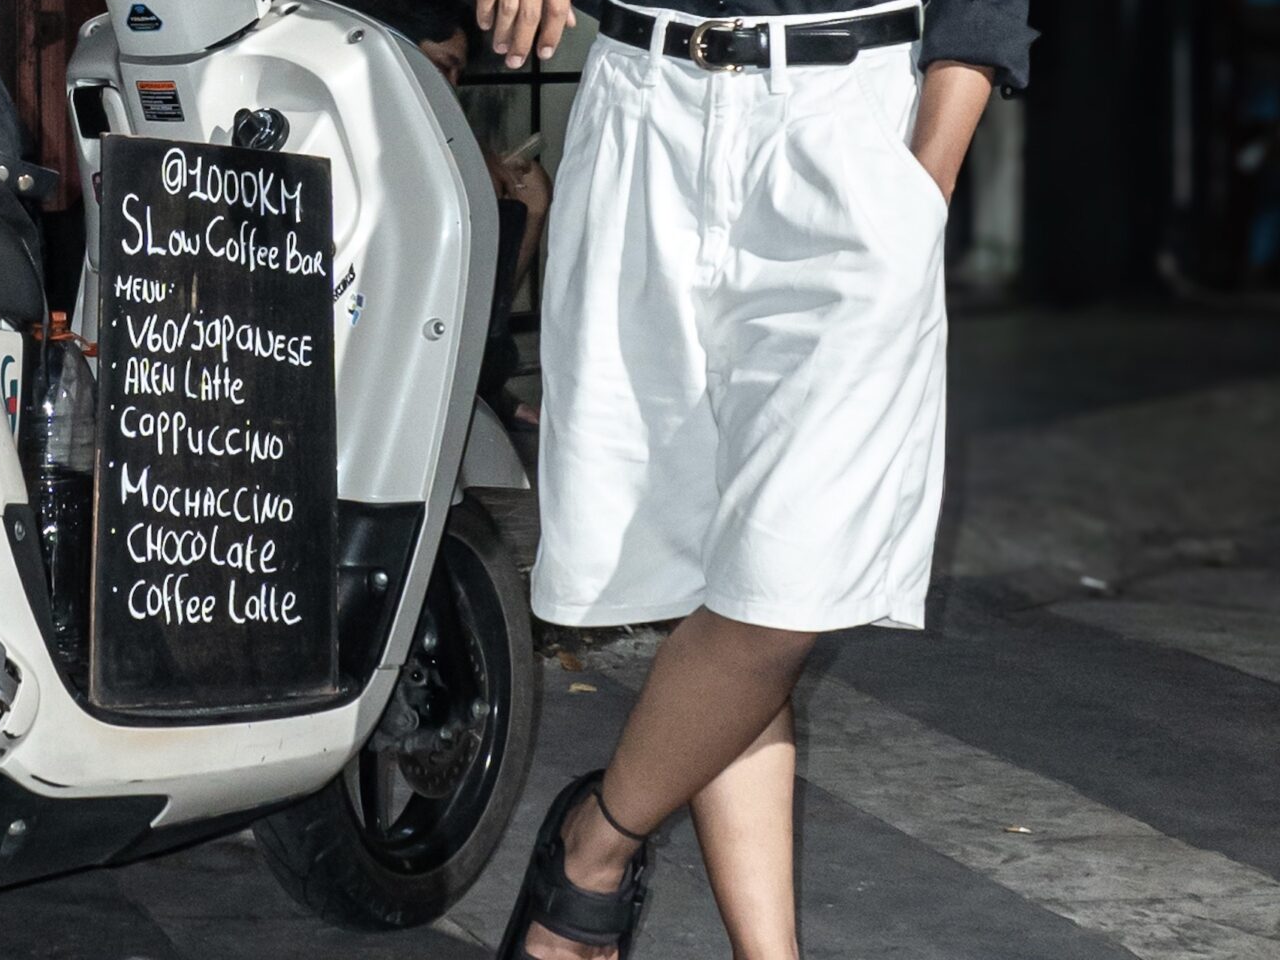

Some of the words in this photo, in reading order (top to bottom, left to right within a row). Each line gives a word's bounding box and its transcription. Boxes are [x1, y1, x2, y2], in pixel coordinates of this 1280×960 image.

[161, 147, 303, 224] @1000KM
[121, 192, 200, 256] SLow
[205, 215, 280, 272] Coffee
[124, 356, 175, 396] AREN
[127, 573, 217, 625] Coffee
